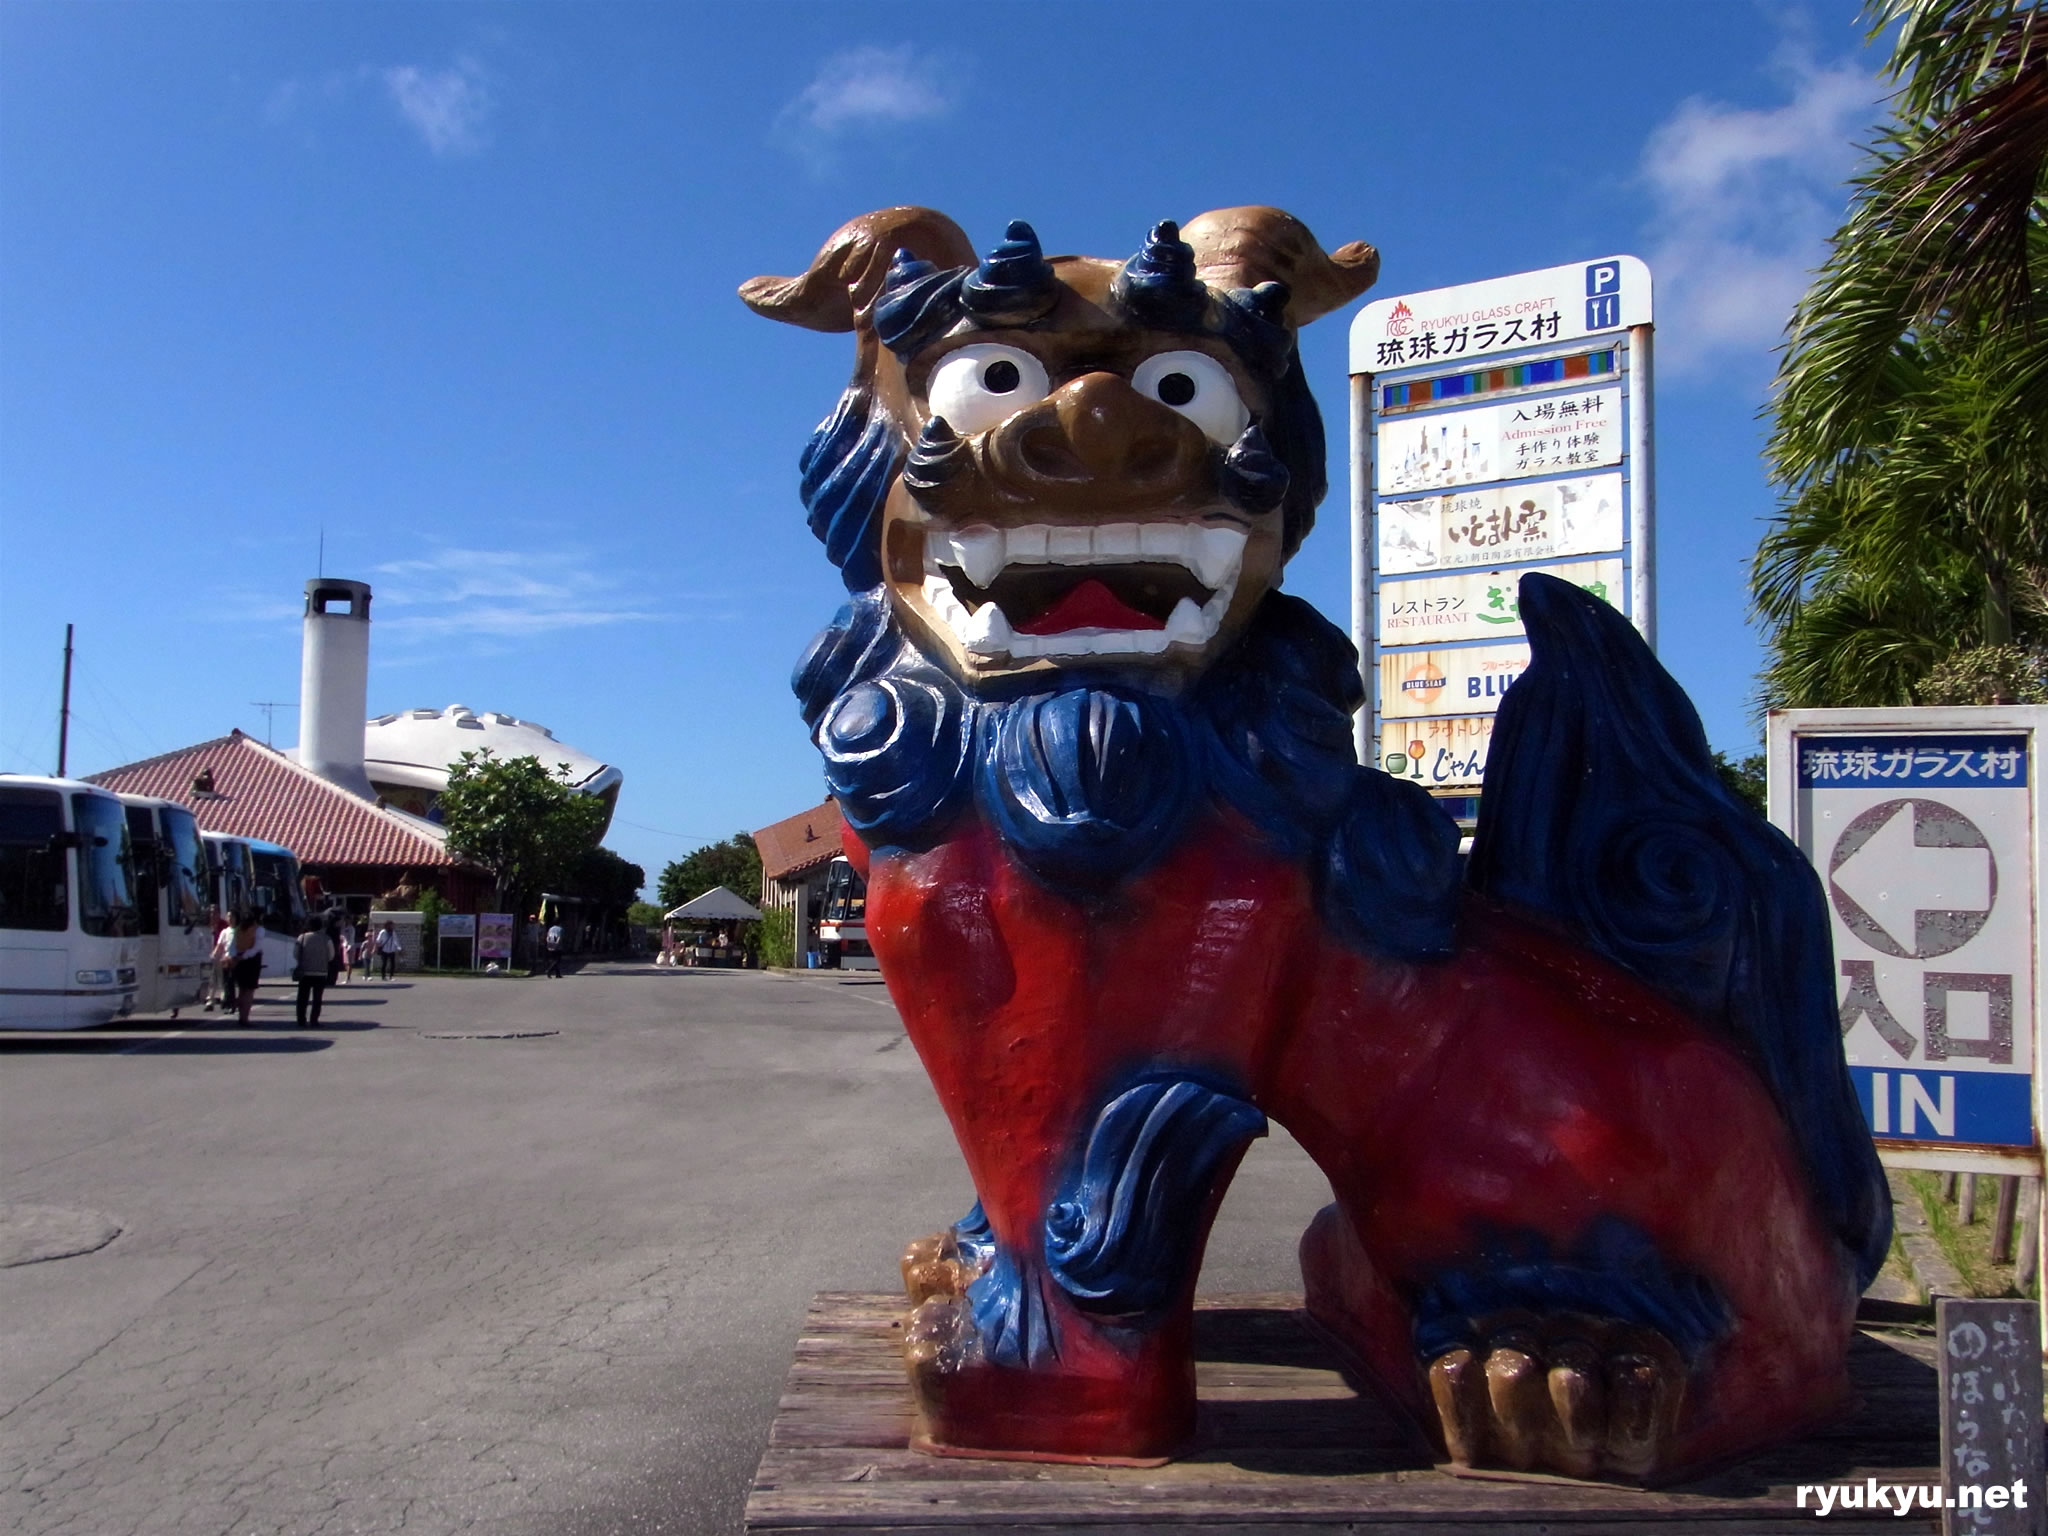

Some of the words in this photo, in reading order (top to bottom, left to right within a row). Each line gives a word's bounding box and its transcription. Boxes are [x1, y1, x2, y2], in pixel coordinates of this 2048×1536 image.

[1595, 267, 1614, 293] P
[1421, 313, 1469, 332] RYUKYU
[1472, 306, 1511, 322] GLASS
[1514, 297, 1555, 314] CRAFT
[1376, 311, 1562, 366] 琉球ガラス村
[1512, 395, 1604, 423] 入場無料
[1501, 424, 1571, 441] Admission
[1576, 419, 1607, 431] Free
[1515, 432, 1600, 456] 手作り体験
[1515, 449, 1599, 470] ガラス教室
[1392, 597, 1465, 616] レストラン
[1387, 611, 1470, 629] RESTAURANT
[1406, 681, 1424, 689] BLUE
[1467, 673, 1521, 698] BLU
[1432, 747, 1485, 782] じゃん
[1802, 745, 2021, 780] 琉球ガラス村
[1839, 959, 2013, 1065] 入口
[1872, 1072, 1956, 1138] IN
